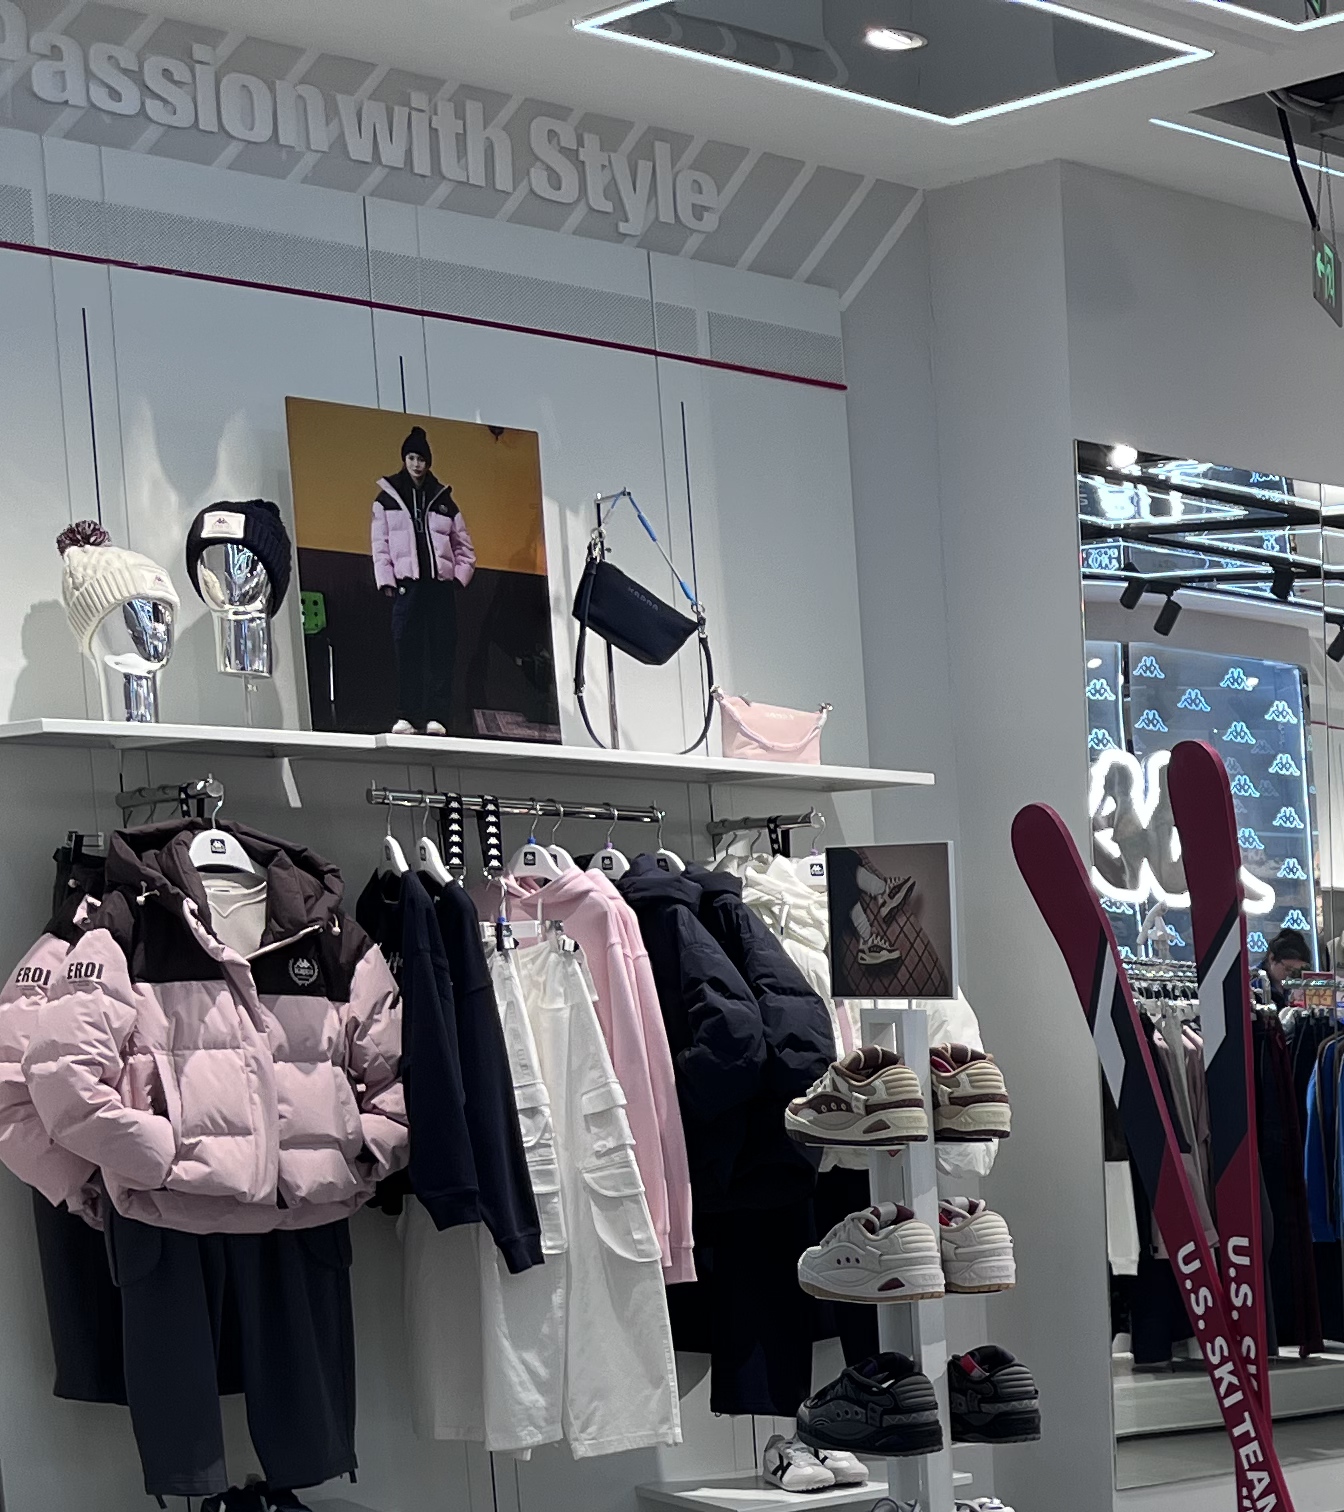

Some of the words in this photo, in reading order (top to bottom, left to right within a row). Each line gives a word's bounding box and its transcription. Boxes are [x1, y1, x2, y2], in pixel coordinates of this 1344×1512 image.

[334, 88, 514, 193] with
[528, 115, 721, 236] Style
[1176, 1240, 1213, 1330] U.S.
[1206, 1335, 1244, 1409] SKI
[1226, 1236, 1254, 1321] U.S.
